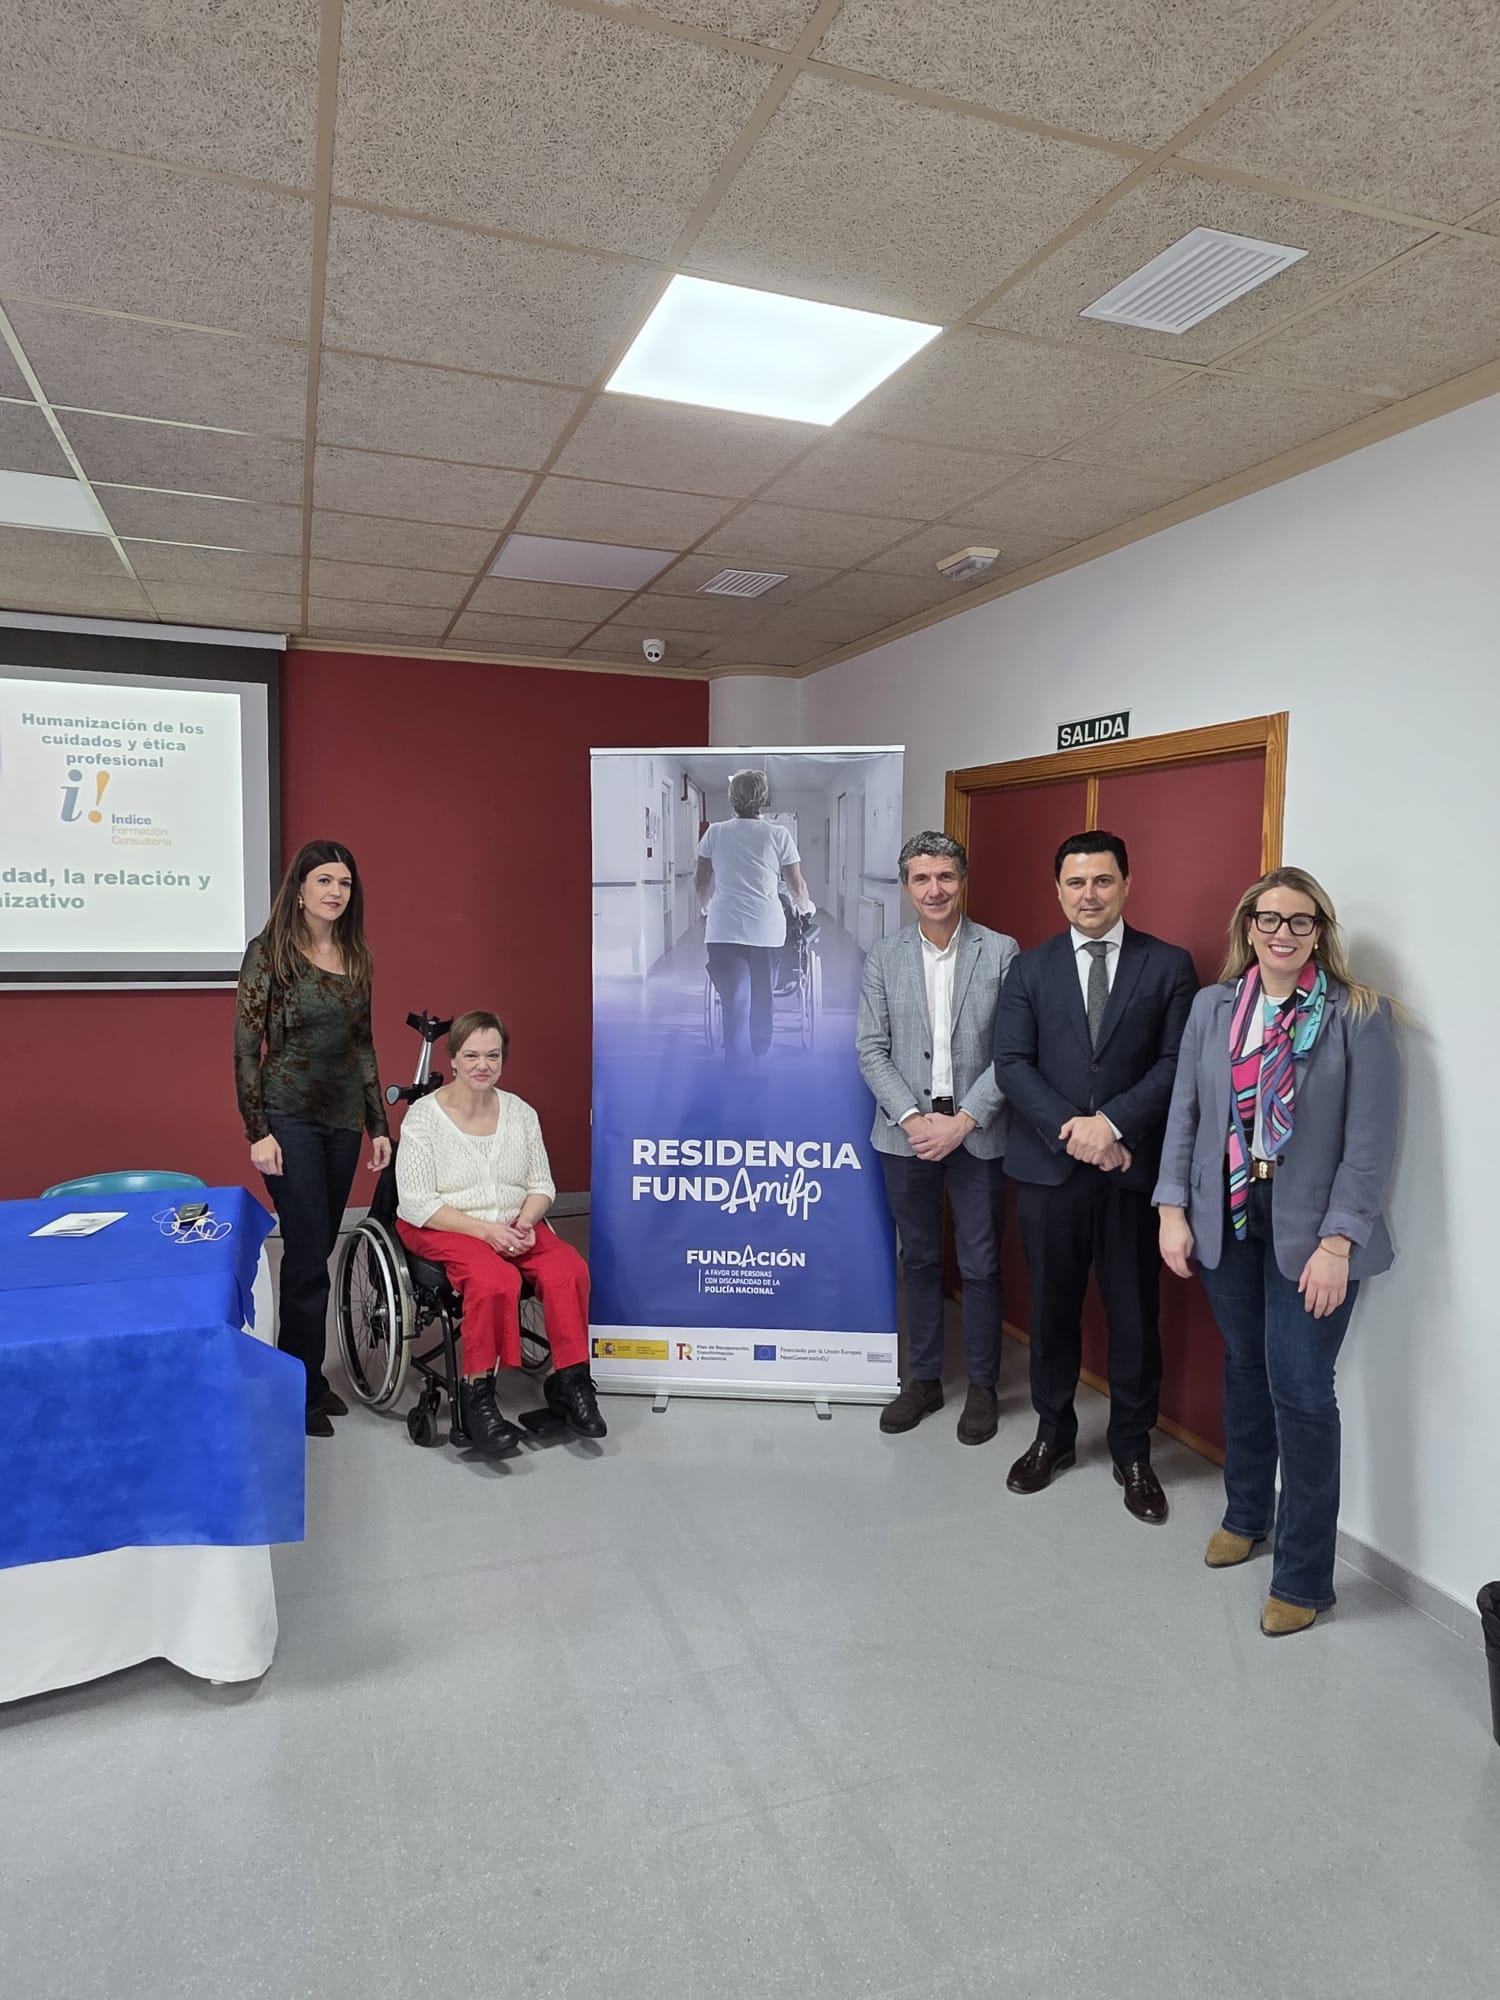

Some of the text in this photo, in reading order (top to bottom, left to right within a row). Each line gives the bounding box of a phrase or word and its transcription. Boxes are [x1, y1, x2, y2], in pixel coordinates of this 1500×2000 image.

[21, 712, 204, 735] Humanización de los
[1060, 716, 1125, 747] SALIDA
[41, 733, 186, 751] cuidados y ética
[66, 752, 164, 768] profesional
[111, 813, 152, 825] Indice
[64, 868, 85, 884] la
[94, 870, 190, 887] relación
[198, 873, 211, 890] y
[0, 892, 85, 909] izativo
[632, 1138, 862, 1170] RESIDENCIA
[686, 1244, 806, 1267] FUNDACIÓN
[711, 1269, 730, 1277] FAVOR
[741, 1270, 772, 1278] PERSONAS
[719, 1278, 762, 1286] DISCAPACIDAD
[705, 1284, 775, 1295] POLICÍA NACIONAL
